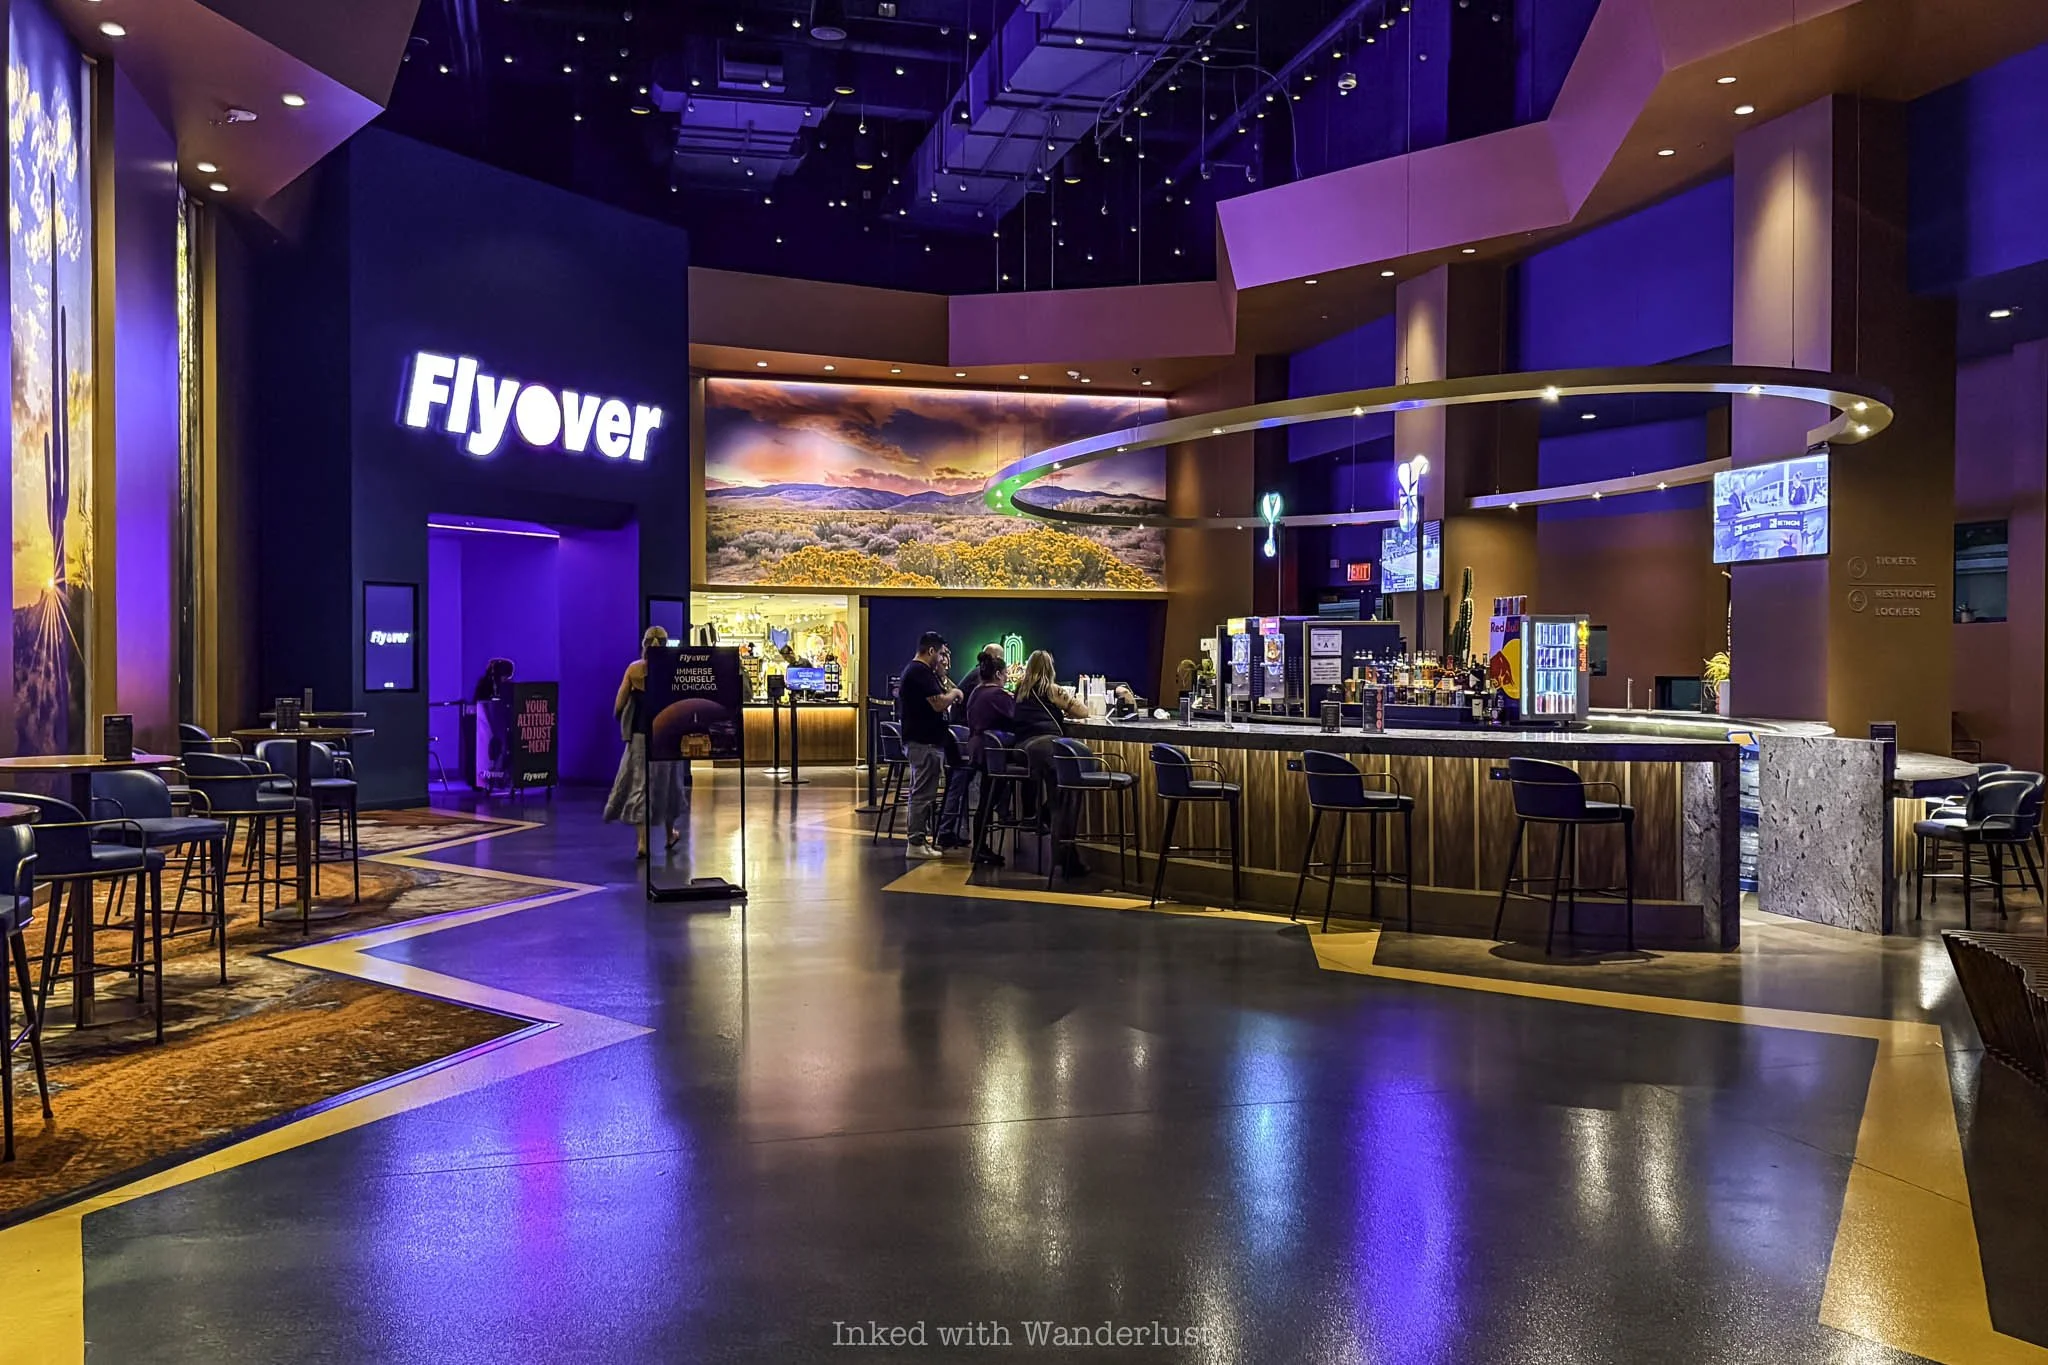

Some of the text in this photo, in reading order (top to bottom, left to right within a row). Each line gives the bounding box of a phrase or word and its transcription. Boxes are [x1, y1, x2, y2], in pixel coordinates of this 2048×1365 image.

[405, 351, 663, 462] Flyover
[1875, 556, 1917, 566] TICKETS
[1352, 565, 1369, 580] EXIT
[1875, 589, 1937, 599] RESTROOMS
[1875, 607, 1921, 617] LOCKERS
[1490, 621, 1505, 633] Red
[370, 630, 410, 646] Flyover
[680, 654, 710, 663] Flyover
[676, 667, 713, 675] IMMERSE
[674, 675, 716, 683] YOURSELF
[671, 683, 680, 691] IN
[525, 699, 548, 713] YOUR
[517, 713, 556, 728] ALTITUDE
[521, 726, 552, 741] ADJUST
[523, 772, 549, 782] Flyover
